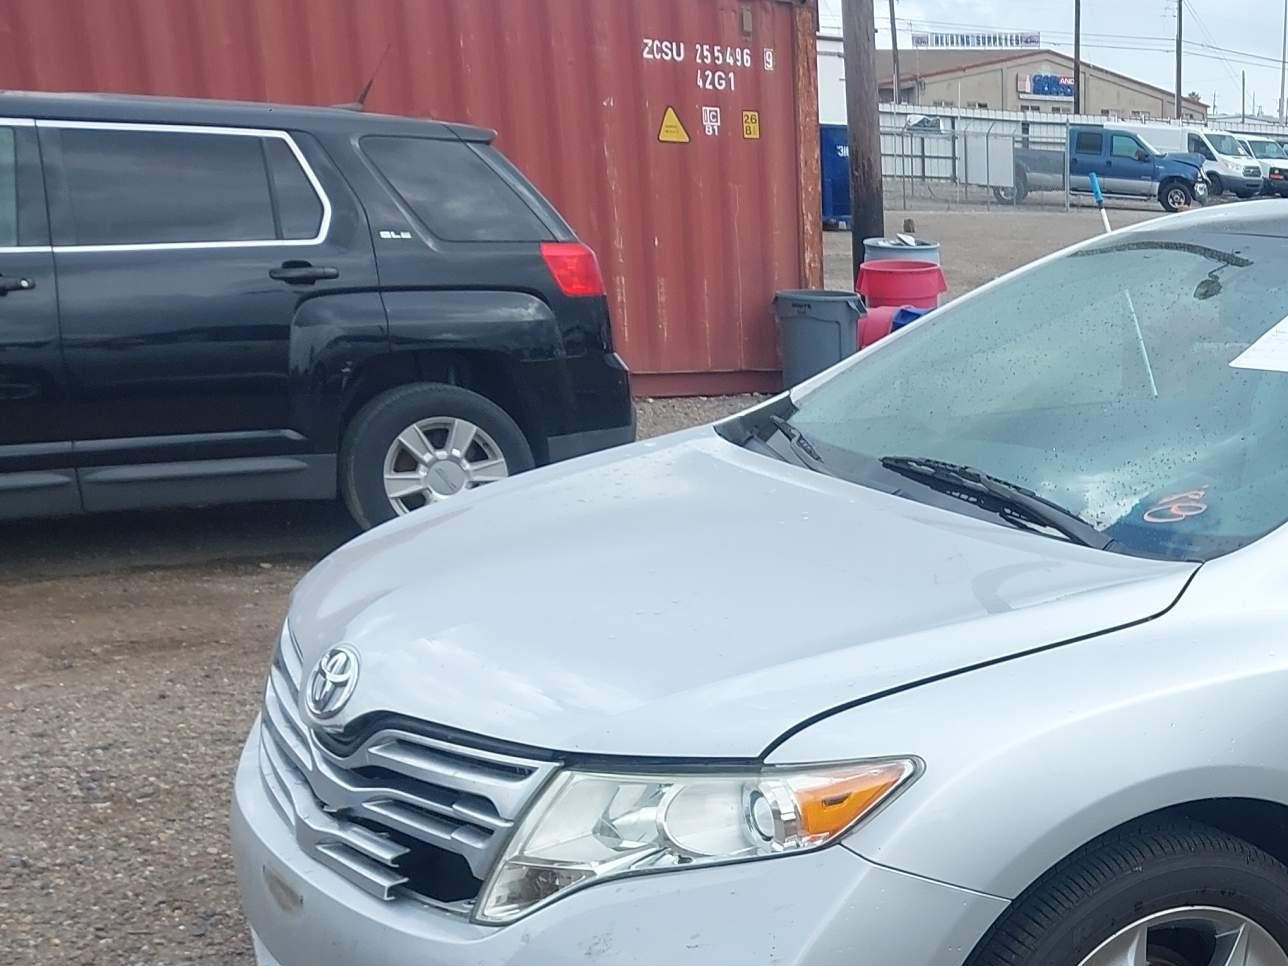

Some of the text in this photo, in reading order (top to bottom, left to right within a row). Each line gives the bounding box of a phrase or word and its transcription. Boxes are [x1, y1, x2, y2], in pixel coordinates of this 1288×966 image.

[642, 38, 774, 71] ZCSU 255496 9
[697, 69, 736, 92] 42G1
